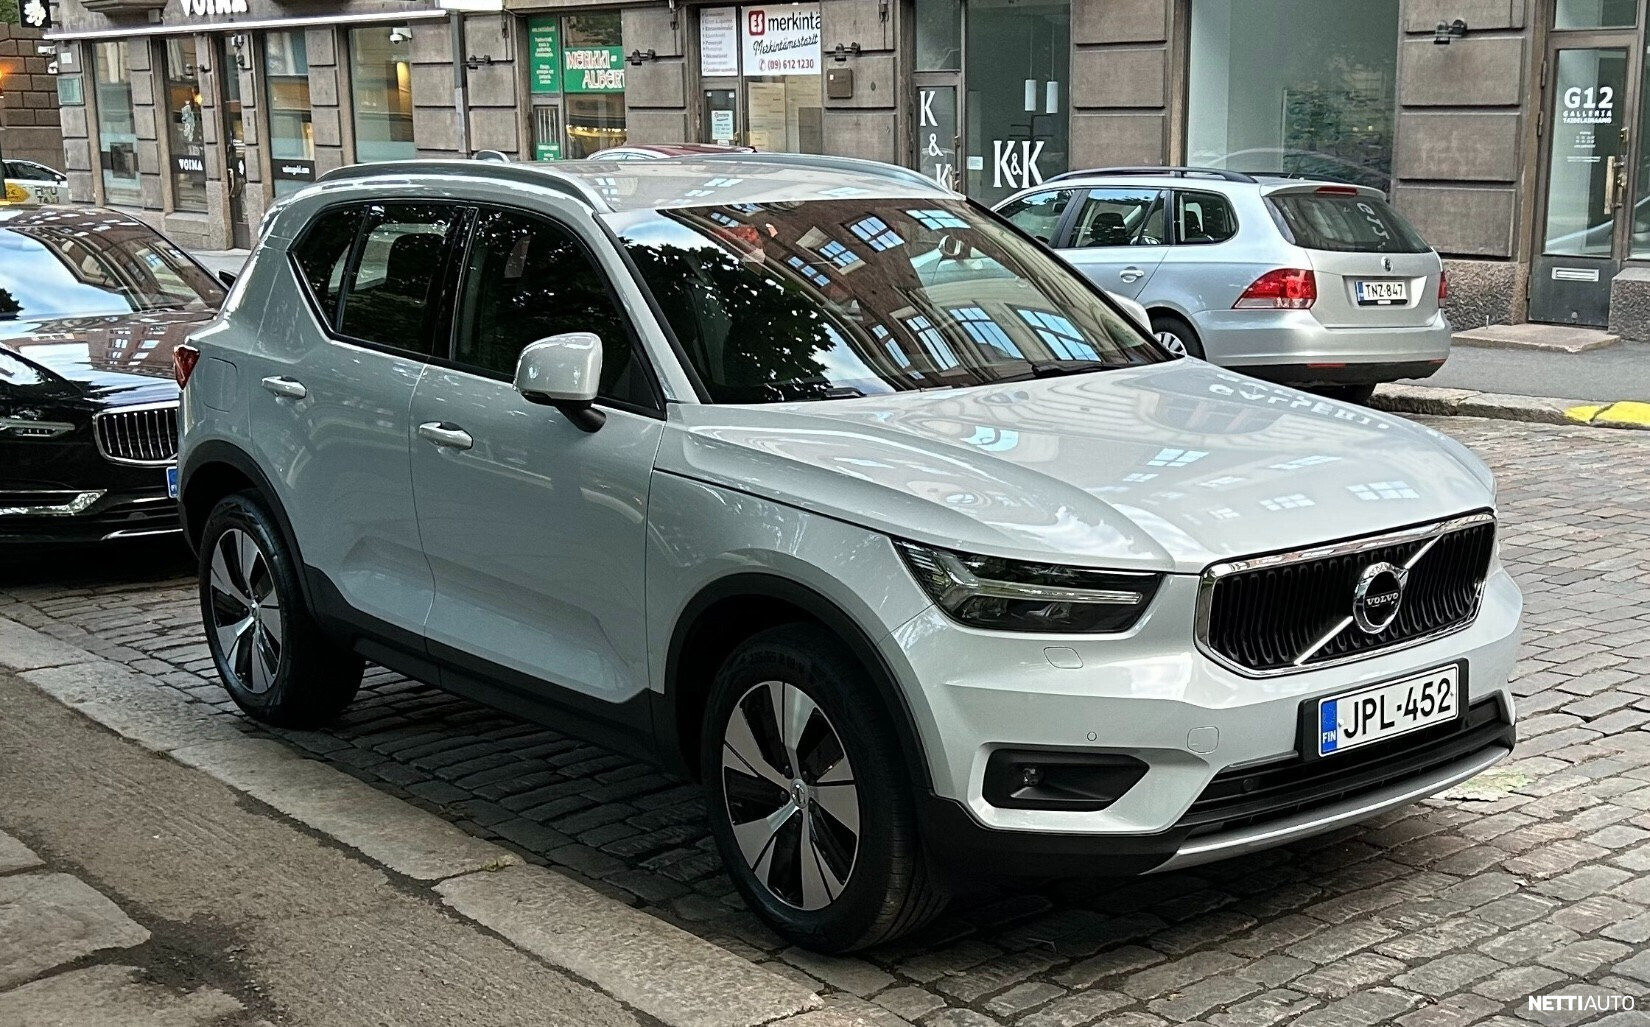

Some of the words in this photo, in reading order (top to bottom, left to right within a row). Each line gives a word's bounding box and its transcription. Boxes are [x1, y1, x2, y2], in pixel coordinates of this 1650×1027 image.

[753, 33, 818, 56] Merkintämestarit
[768, 59, 781, 71] (09)
[783, 59, 795, 69] 612
[797, 58, 814, 69] 1230
[582, 69, 625, 88] ALBERT
[1564, 86, 1613, 109] G12
[178, 158, 203, 171] VOIMA
[993, 140, 1045, 188] K&K
[1365, 284, 1403, 297] TNZ-847
[1366, 592, 1399, 605] VOLVO
[1343, 677, 1451, 738] JPL-452
[1322, 730, 1337, 743] FIN
